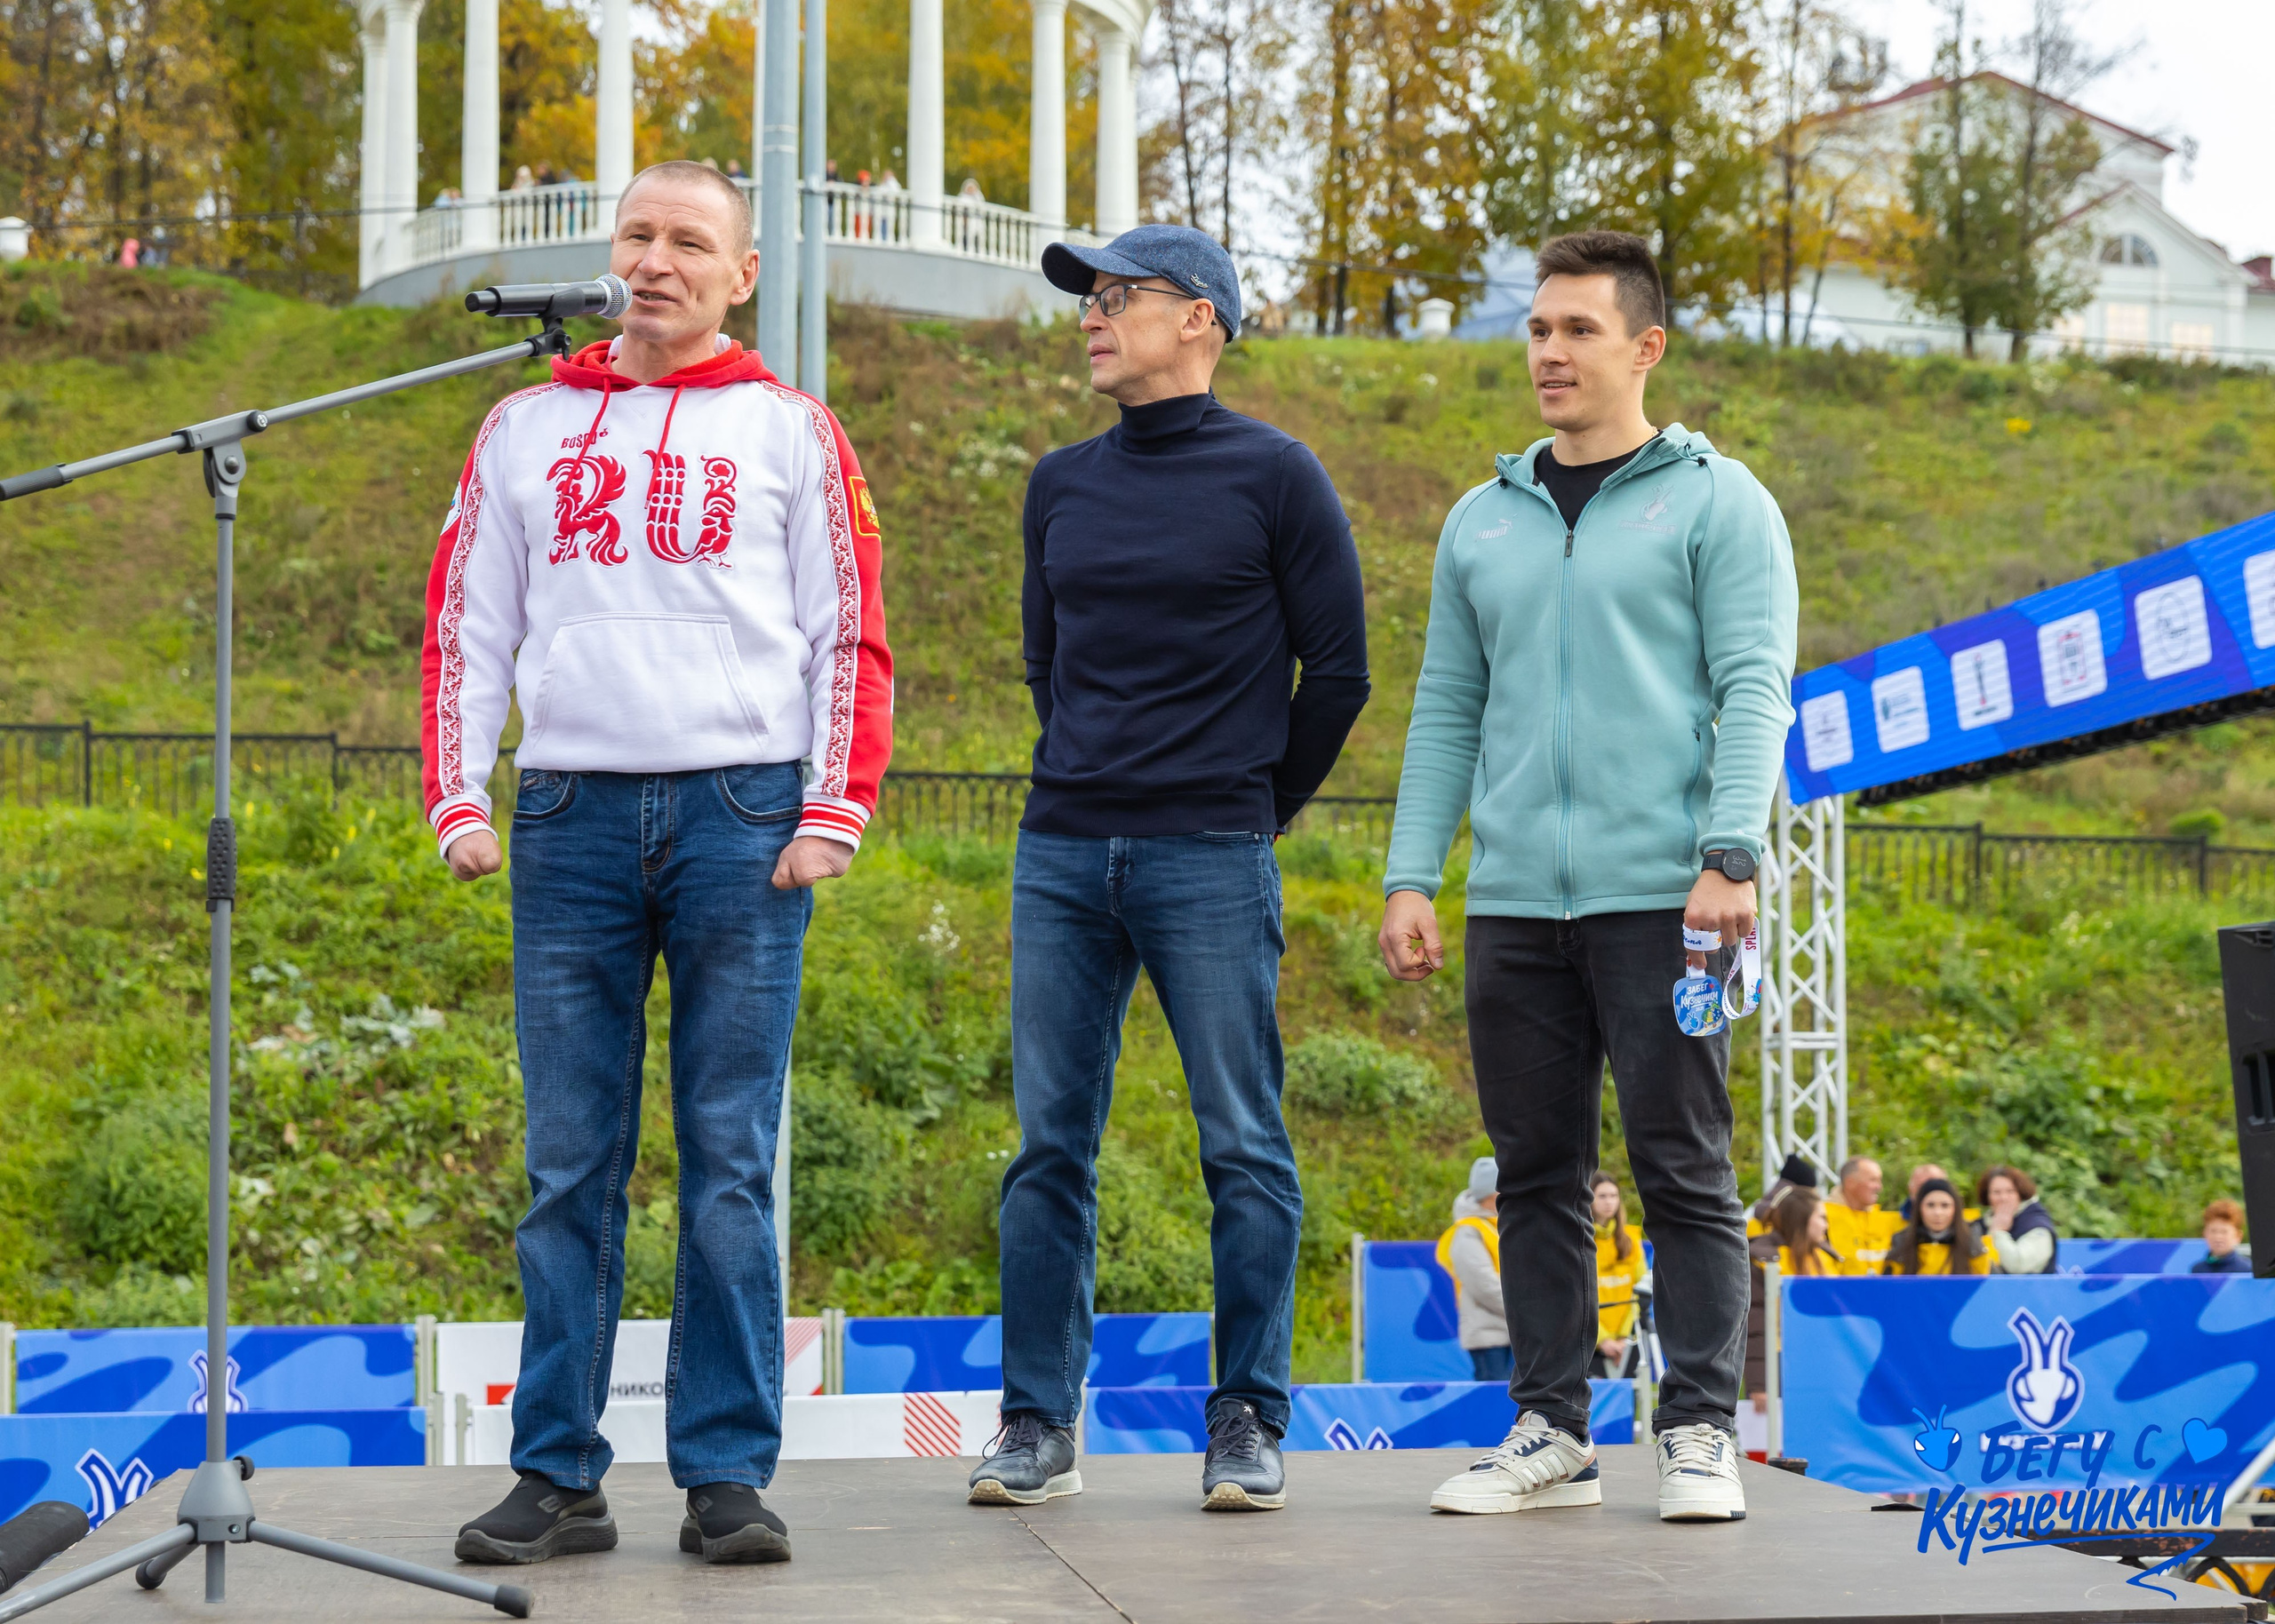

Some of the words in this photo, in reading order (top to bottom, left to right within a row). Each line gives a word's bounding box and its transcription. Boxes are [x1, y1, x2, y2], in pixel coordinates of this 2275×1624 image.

[546, 450, 737, 569] RU
[1744, 927, 1757, 951] SPLA
[1687, 983, 1708, 994] ЗАБЕГ
[611, 1381, 665, 1397] НИКО
